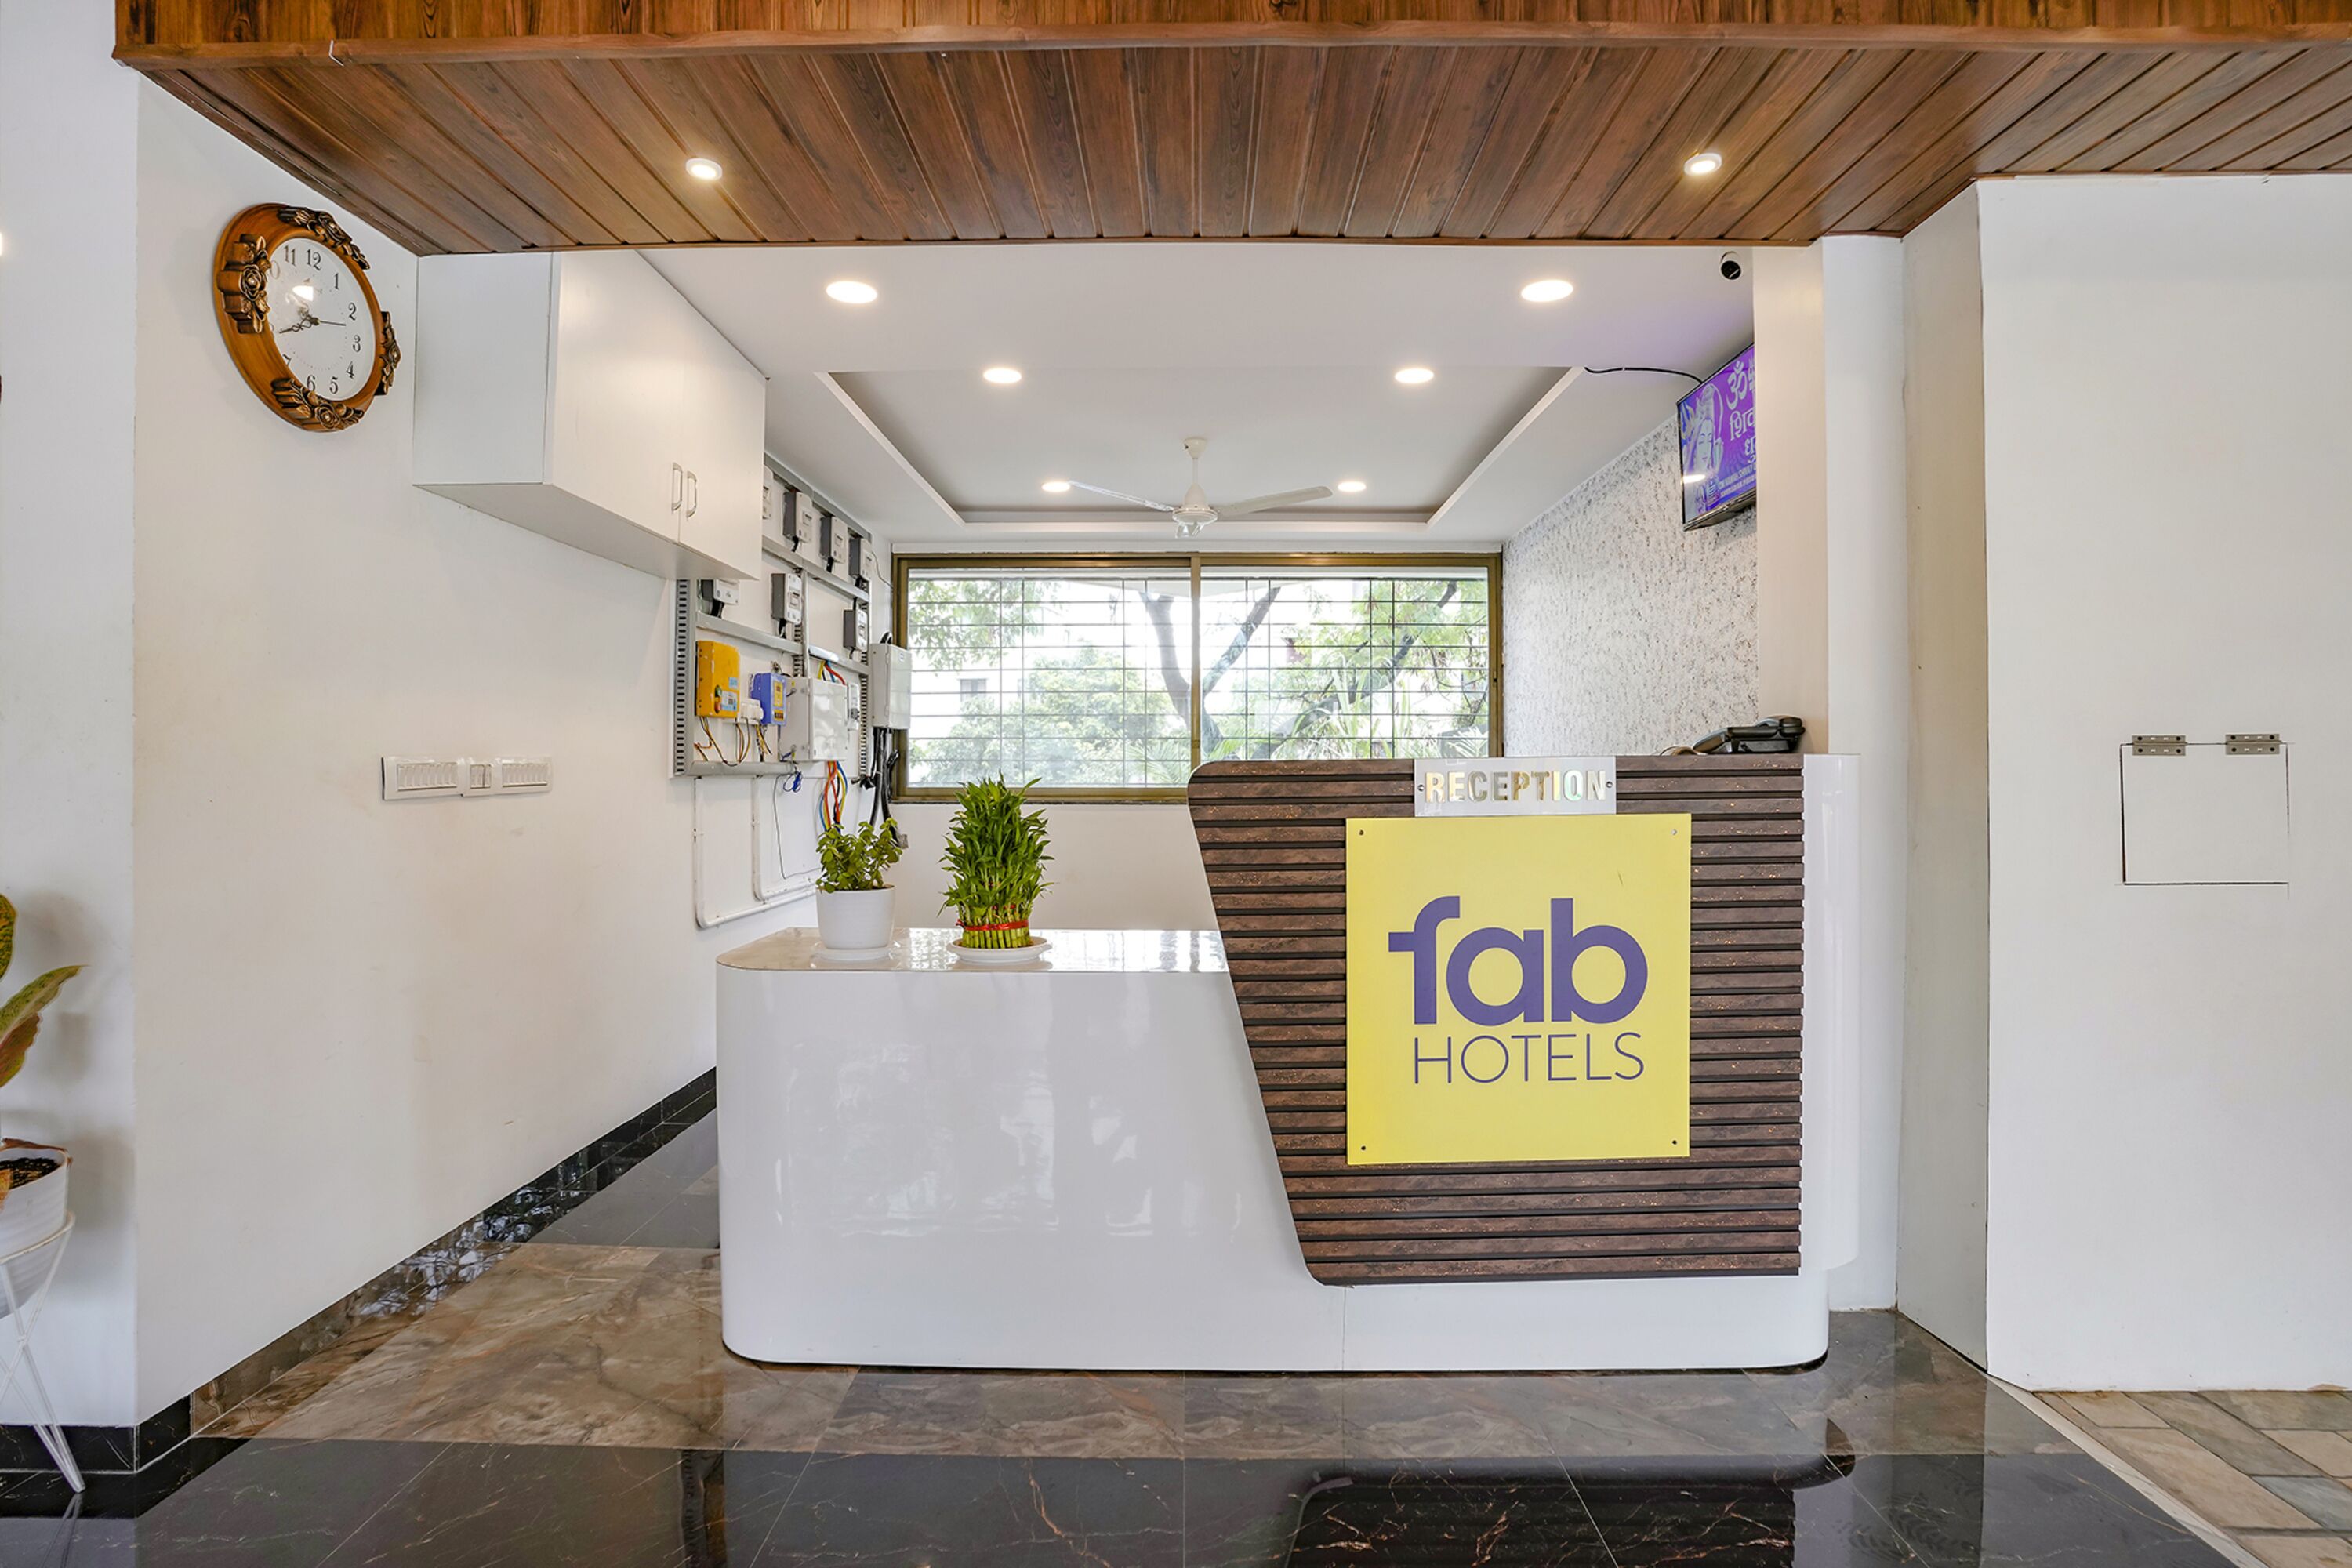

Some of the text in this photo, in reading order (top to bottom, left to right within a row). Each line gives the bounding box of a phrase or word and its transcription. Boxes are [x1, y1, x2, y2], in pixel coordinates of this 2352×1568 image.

[284, 245, 296, 267] 11
[307, 248, 321, 271] 12
[333, 272, 340, 290] 1
[347, 302, 358, 321] 2
[352, 335, 361, 353] 3
[346, 361, 355, 379] 4
[307, 375, 316, 392] 6
[329, 376, 339, 394] 5
[1425, 770, 1607, 804] RECEPTION
[1388, 895, 1648, 1027] fab
[1414, 1032, 1645, 1084] HOTELS
